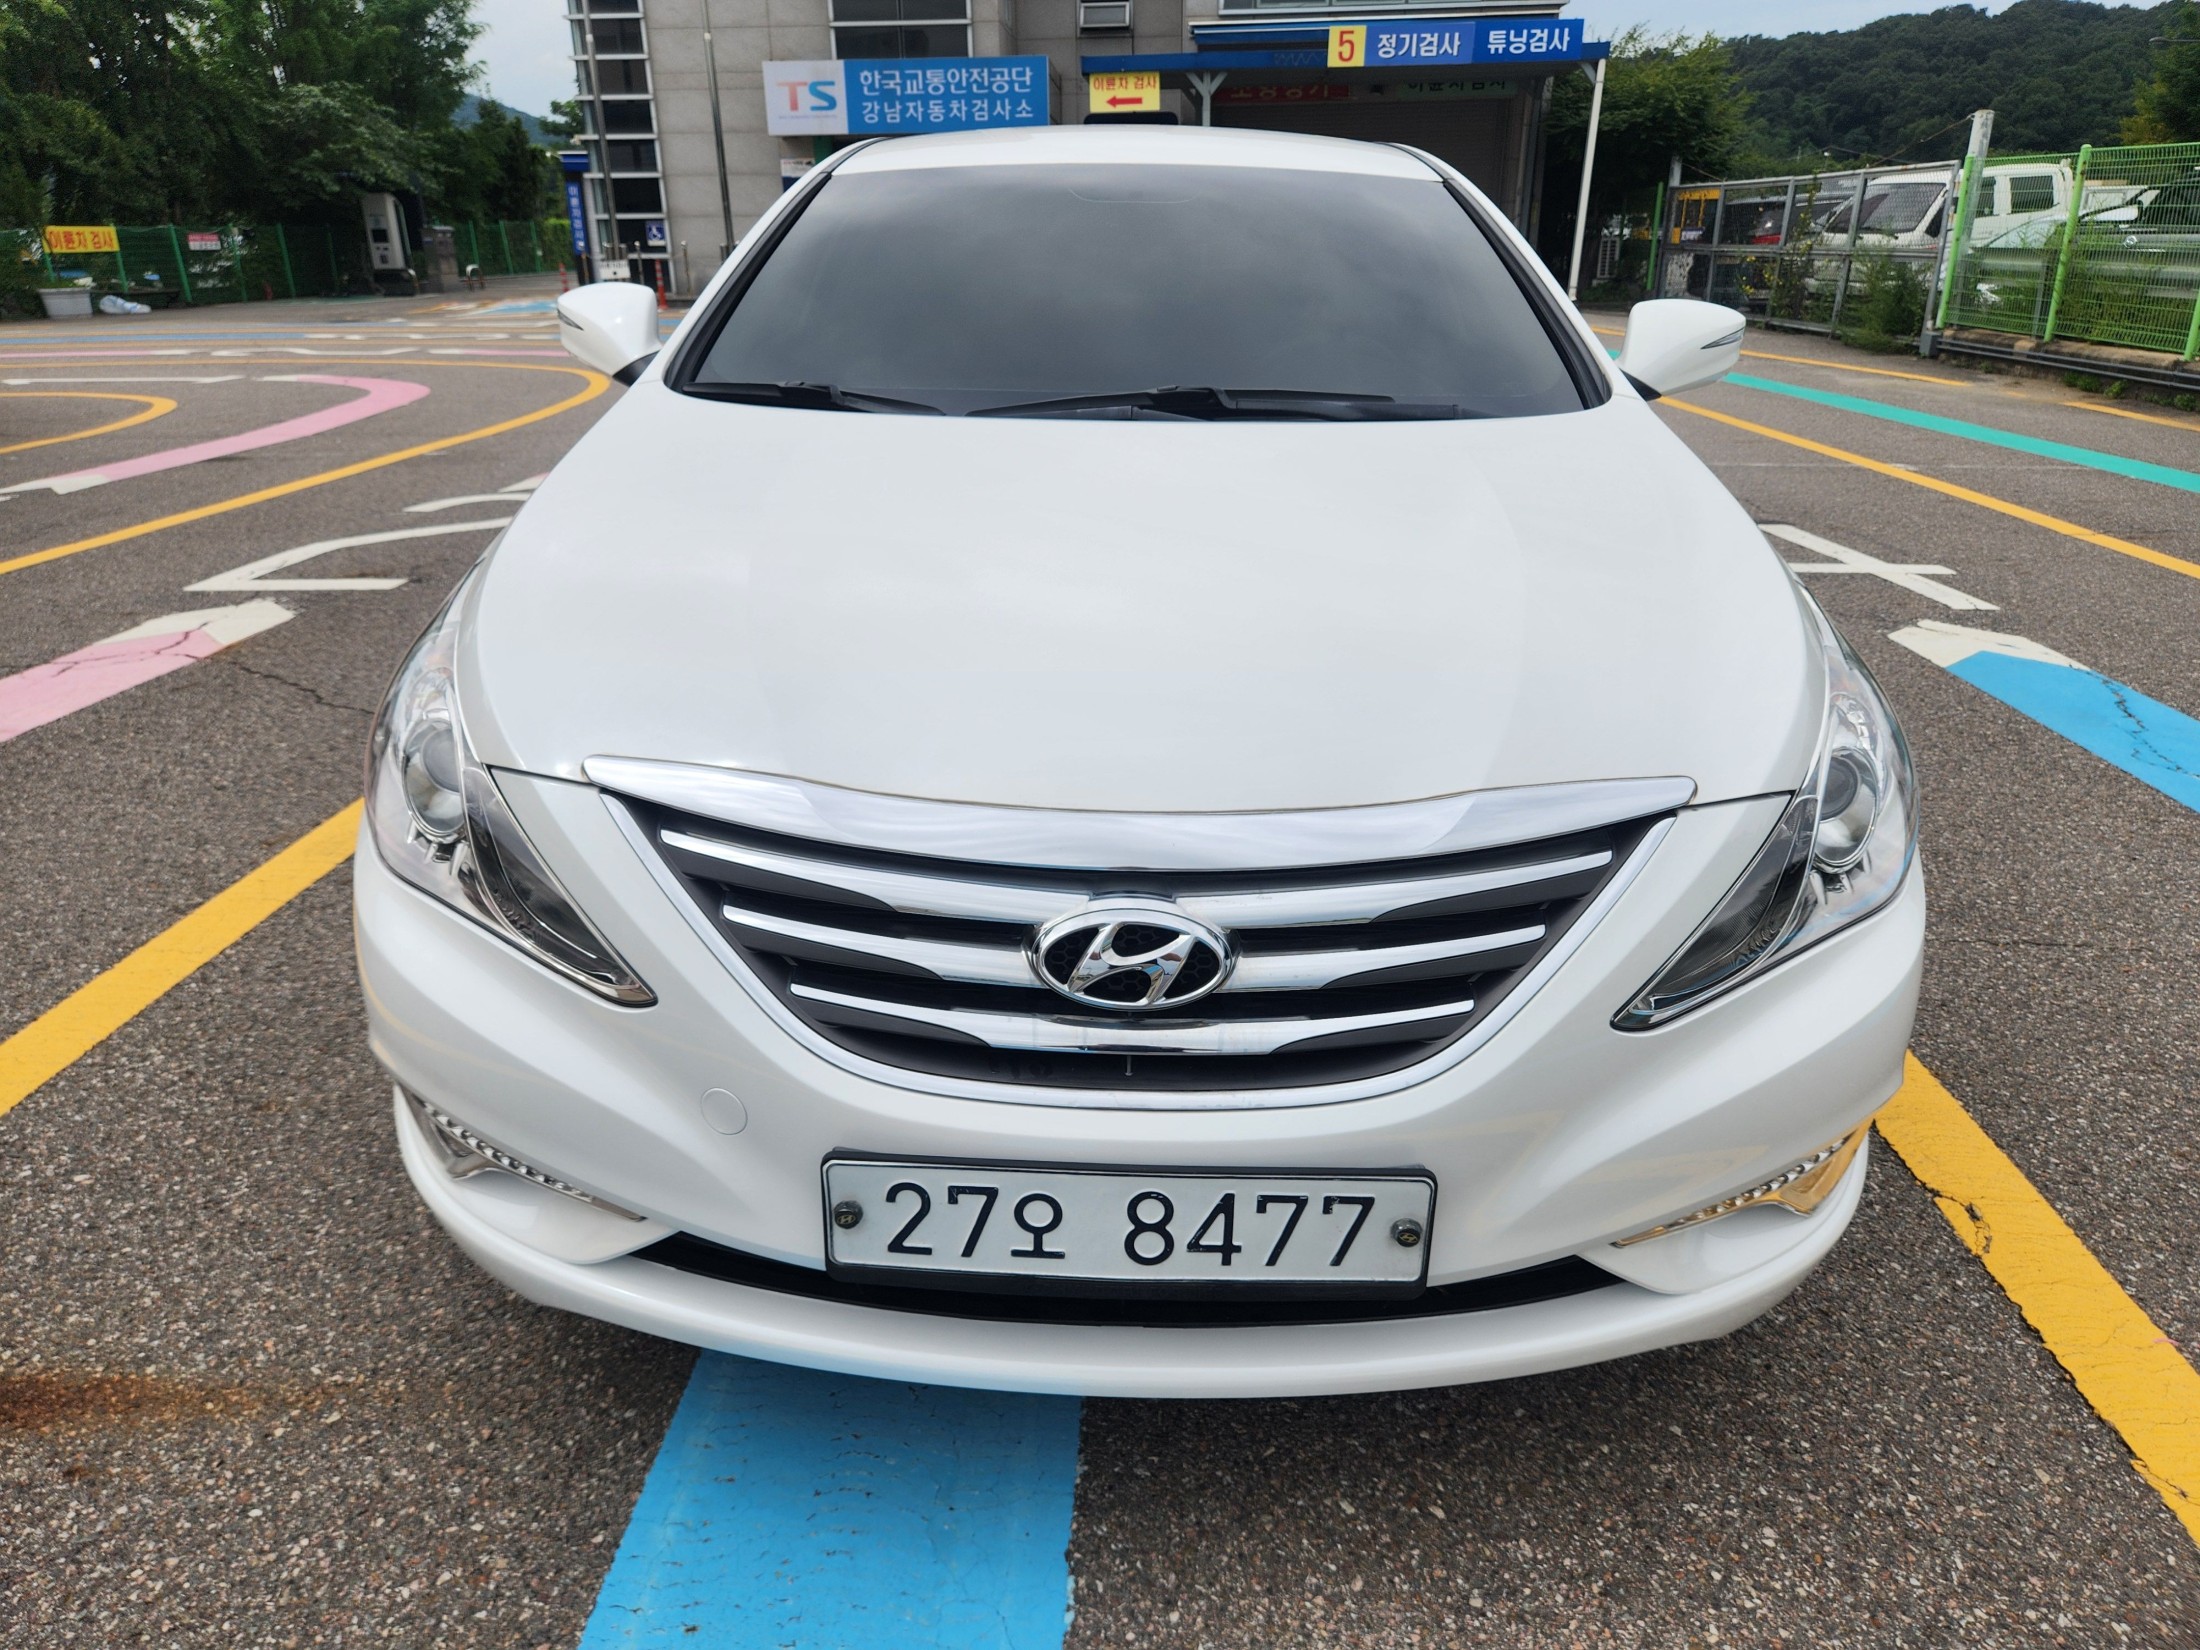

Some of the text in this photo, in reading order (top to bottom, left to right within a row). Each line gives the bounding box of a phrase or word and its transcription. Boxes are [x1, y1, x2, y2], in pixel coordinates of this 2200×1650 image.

[1337, 27, 1571, 63] 5 정기검사 튜닝검사
[776, 80, 838, 112] TS
[859, 67, 1034, 96] 한국교통안전공단
[1134, 75, 1157, 90] 검사
[861, 98, 1034, 124] 강남자동차검사소
[885, 1182, 1376, 1268] 27오 8477
